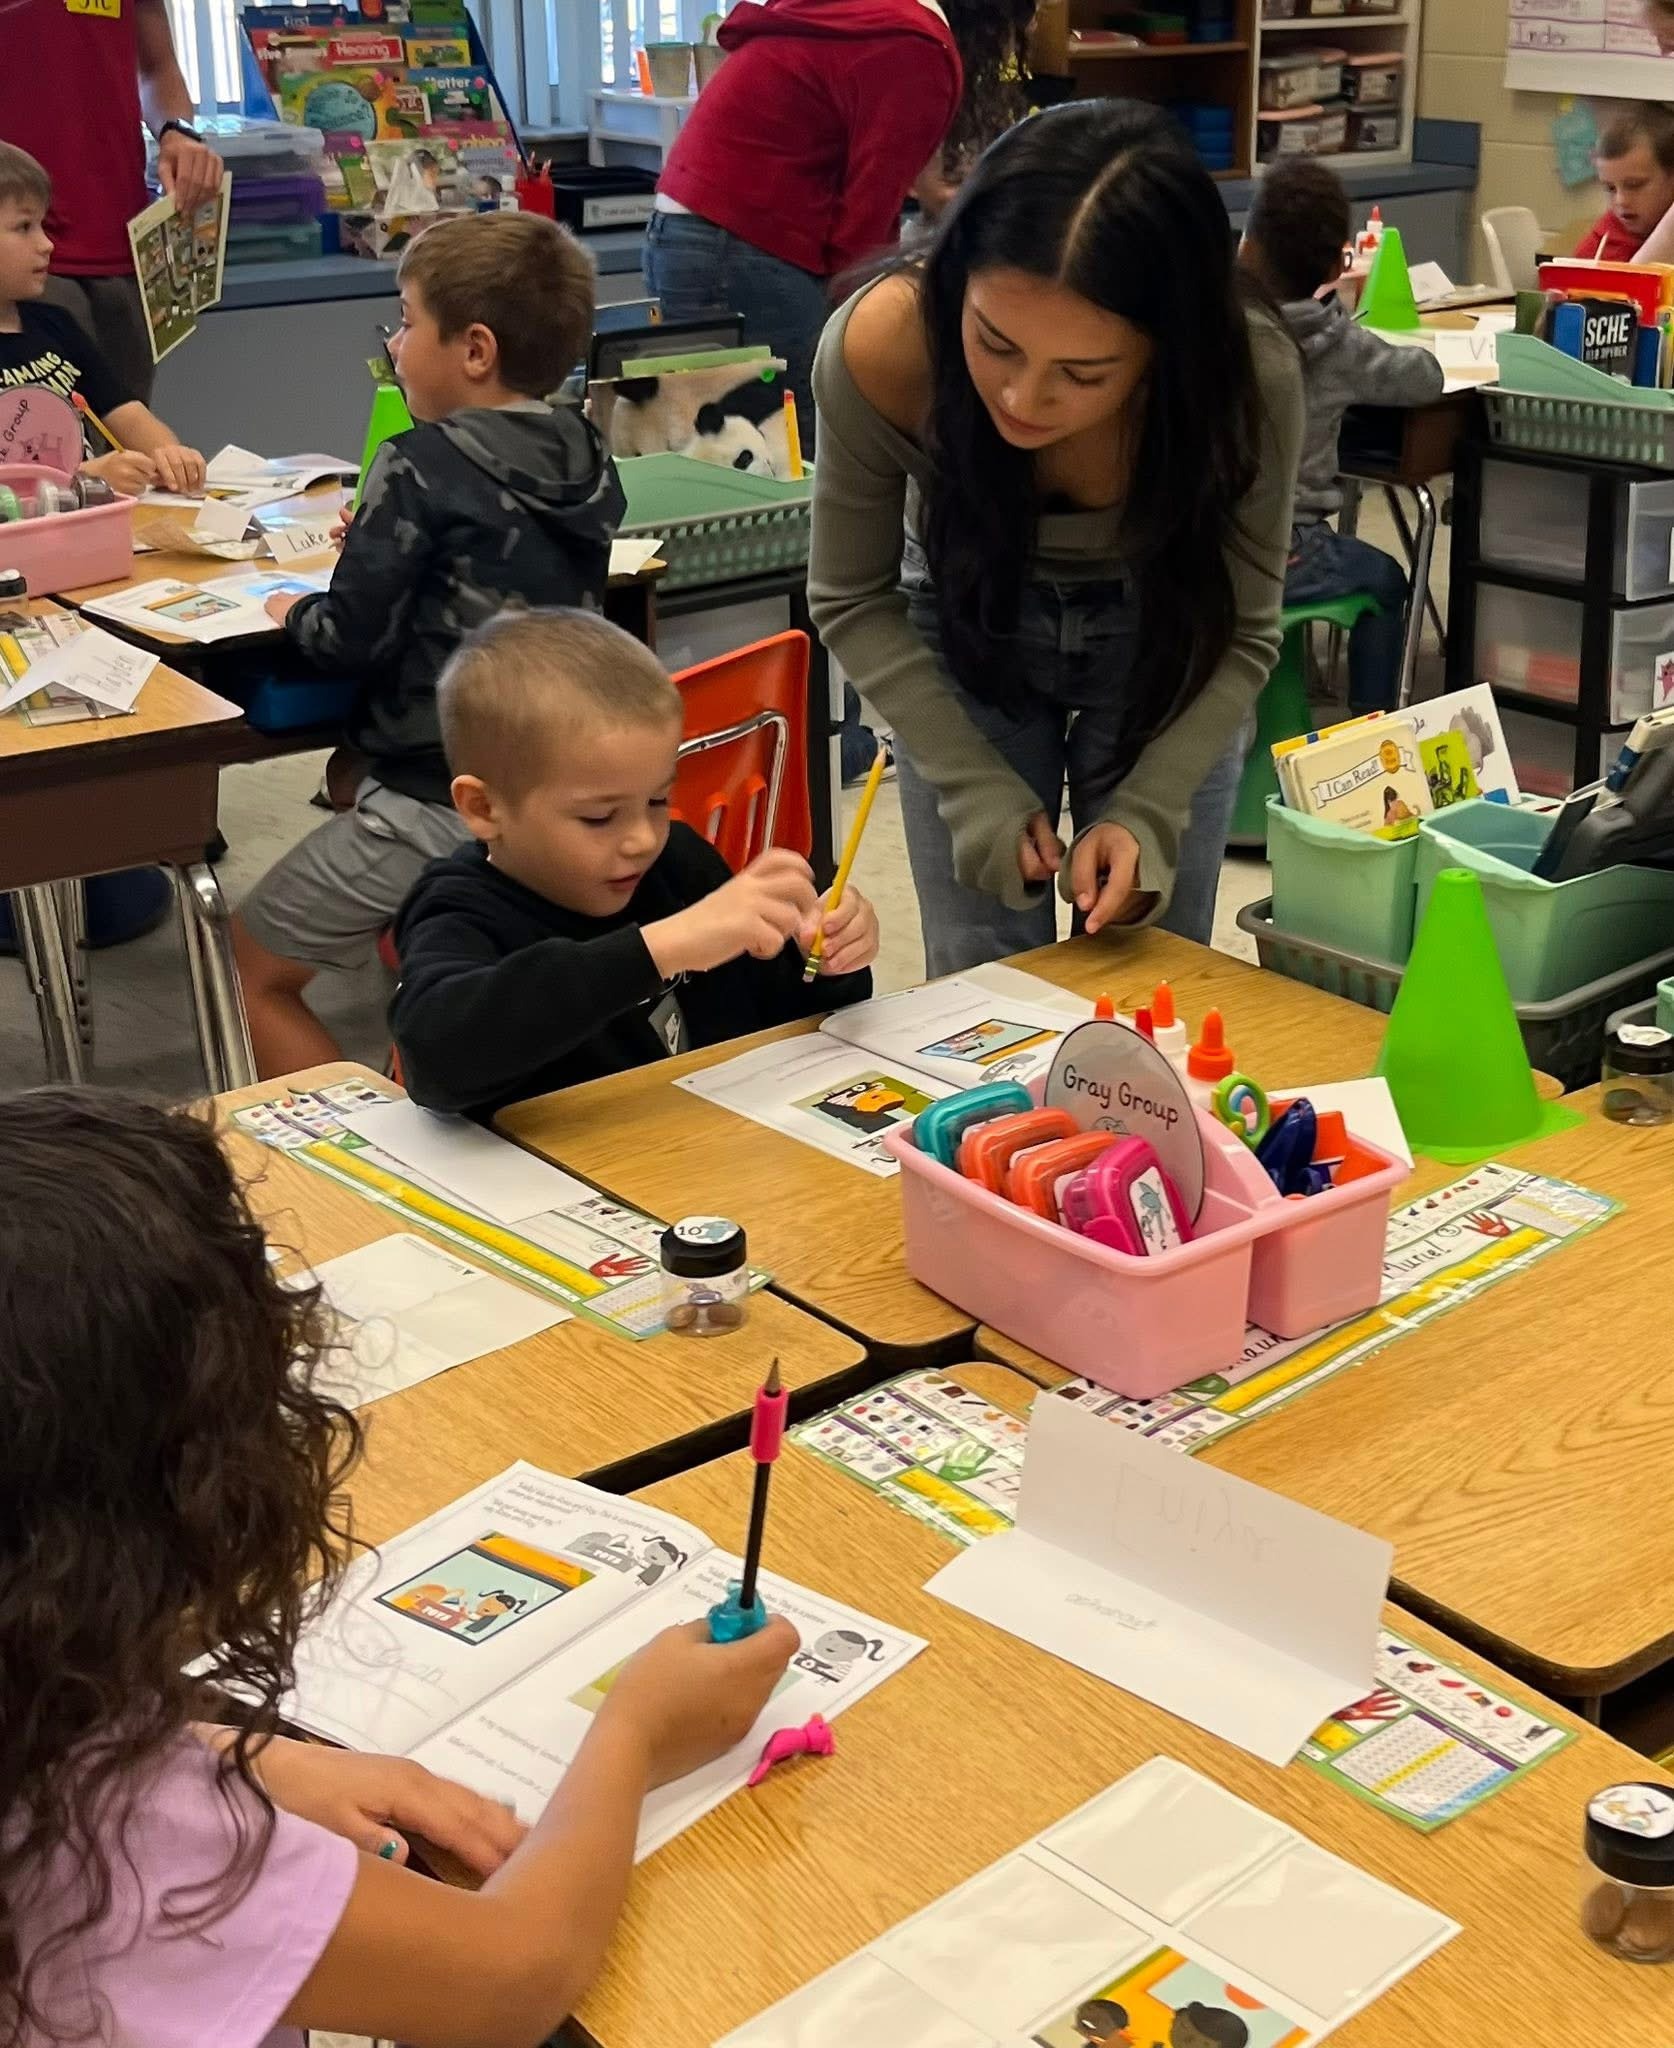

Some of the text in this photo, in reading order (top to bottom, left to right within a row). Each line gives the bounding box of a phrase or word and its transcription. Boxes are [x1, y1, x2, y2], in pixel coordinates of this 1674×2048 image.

[337, 40, 390, 57] Hearing
[3, 399, 30, 442] Group
[286, 530, 329, 552] Luke
[1333, 775, 1354, 795] Can
[1353, 761, 1379, 782] Read!
[1063, 1064, 1179, 1130] Gray Group
[678, 1226, 702, 1236] 10
[1382, 1240, 1452, 1279] Muriel
